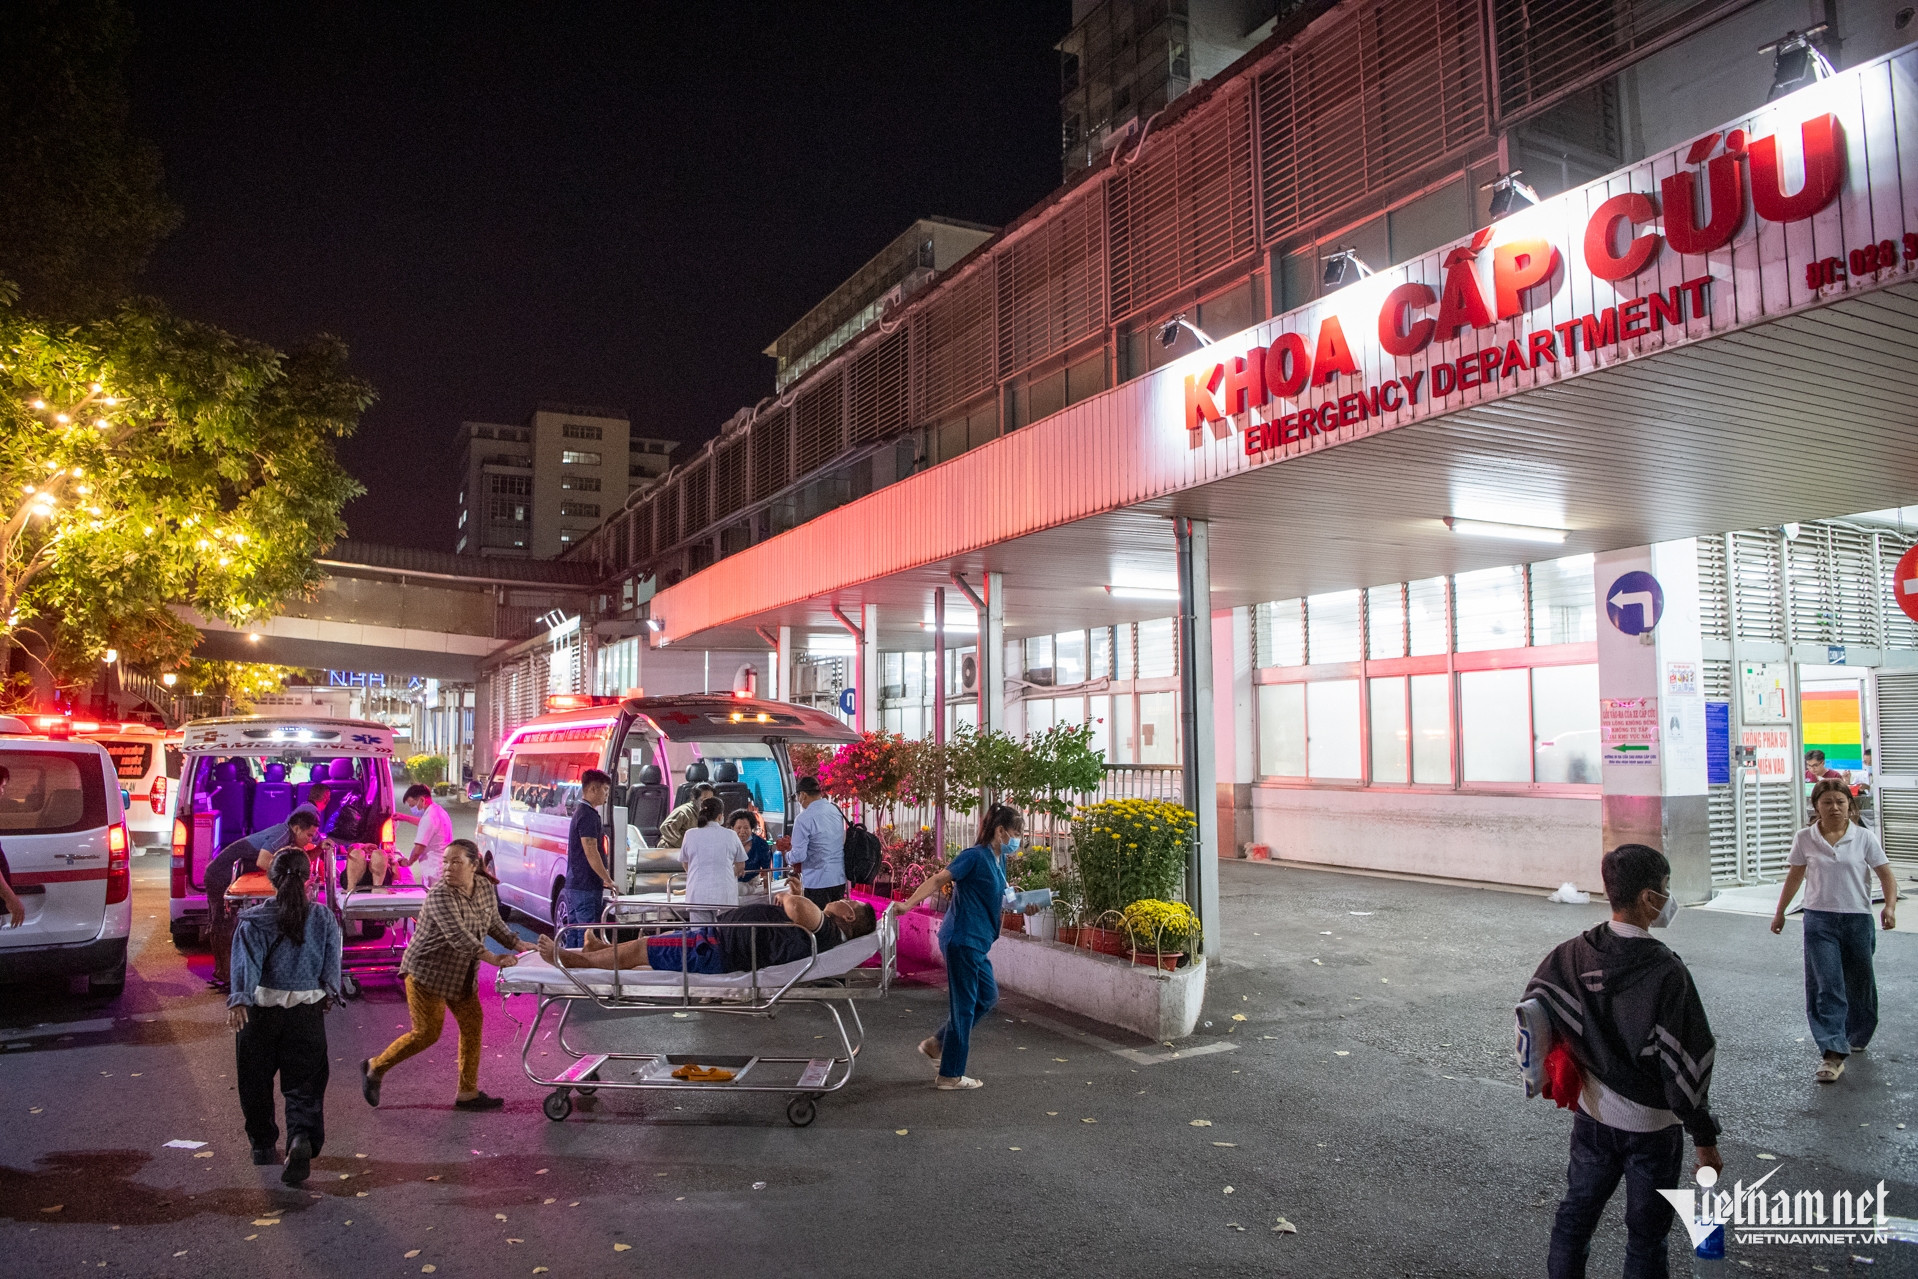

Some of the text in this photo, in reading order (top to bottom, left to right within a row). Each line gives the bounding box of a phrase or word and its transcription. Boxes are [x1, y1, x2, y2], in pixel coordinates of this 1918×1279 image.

[1184, 112, 1843, 430] KHOA CẤP CỨU
[1849, 239, 1895, 276] 028
[1245, 275, 1711, 455] EMERGENCY DEPARTMENT
[1742, 729, 1762, 749] KHÔNG
